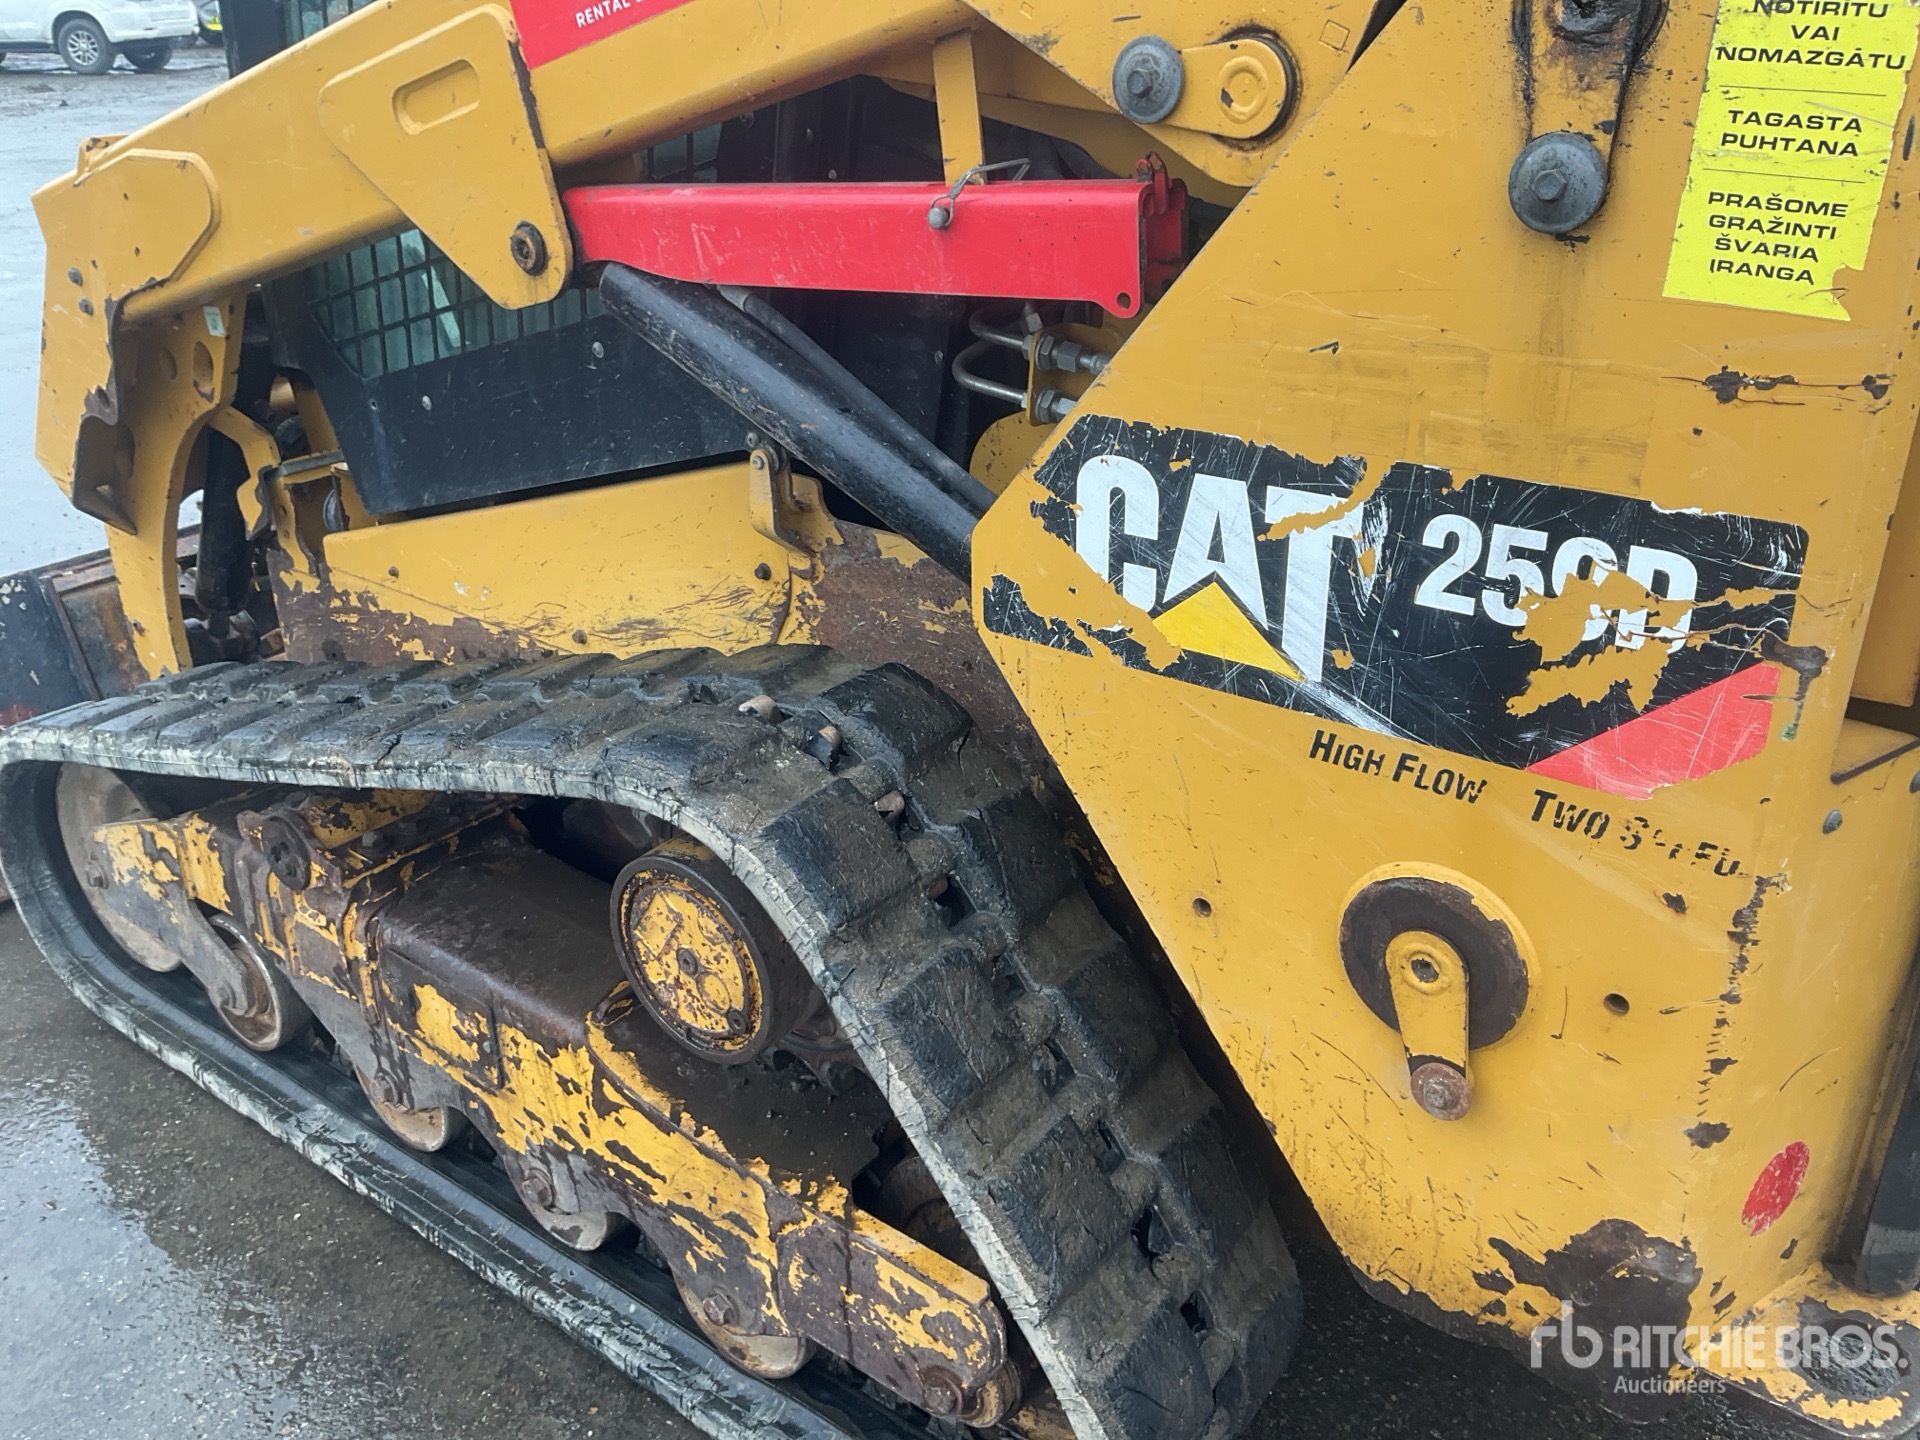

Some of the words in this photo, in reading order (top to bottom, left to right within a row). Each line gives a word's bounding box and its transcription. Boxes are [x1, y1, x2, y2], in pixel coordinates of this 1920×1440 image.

[575, 0, 631, 28] RENTAL
[1791, 24, 1840, 41] VAI
[1716, 46, 1906, 70] NOMAZGĀTU
[1728, 109, 1863, 133] TAGASTA
[1721, 132, 1859, 157] PUHTANA
[1707, 191, 1849, 218] PRAŠOME
[1708, 215, 1838, 240] GRĄŽINTI
[1714, 232, 1820, 263] ŠVARIĄ
[1709, 258, 1815, 286] ĮRANGĄ
[1076, 454, 1364, 682] CAT
[1309, 729, 1386, 776] HIGH
[1392, 752, 1488, 804] FLOW
[1531, 788, 1610, 840] TWO
